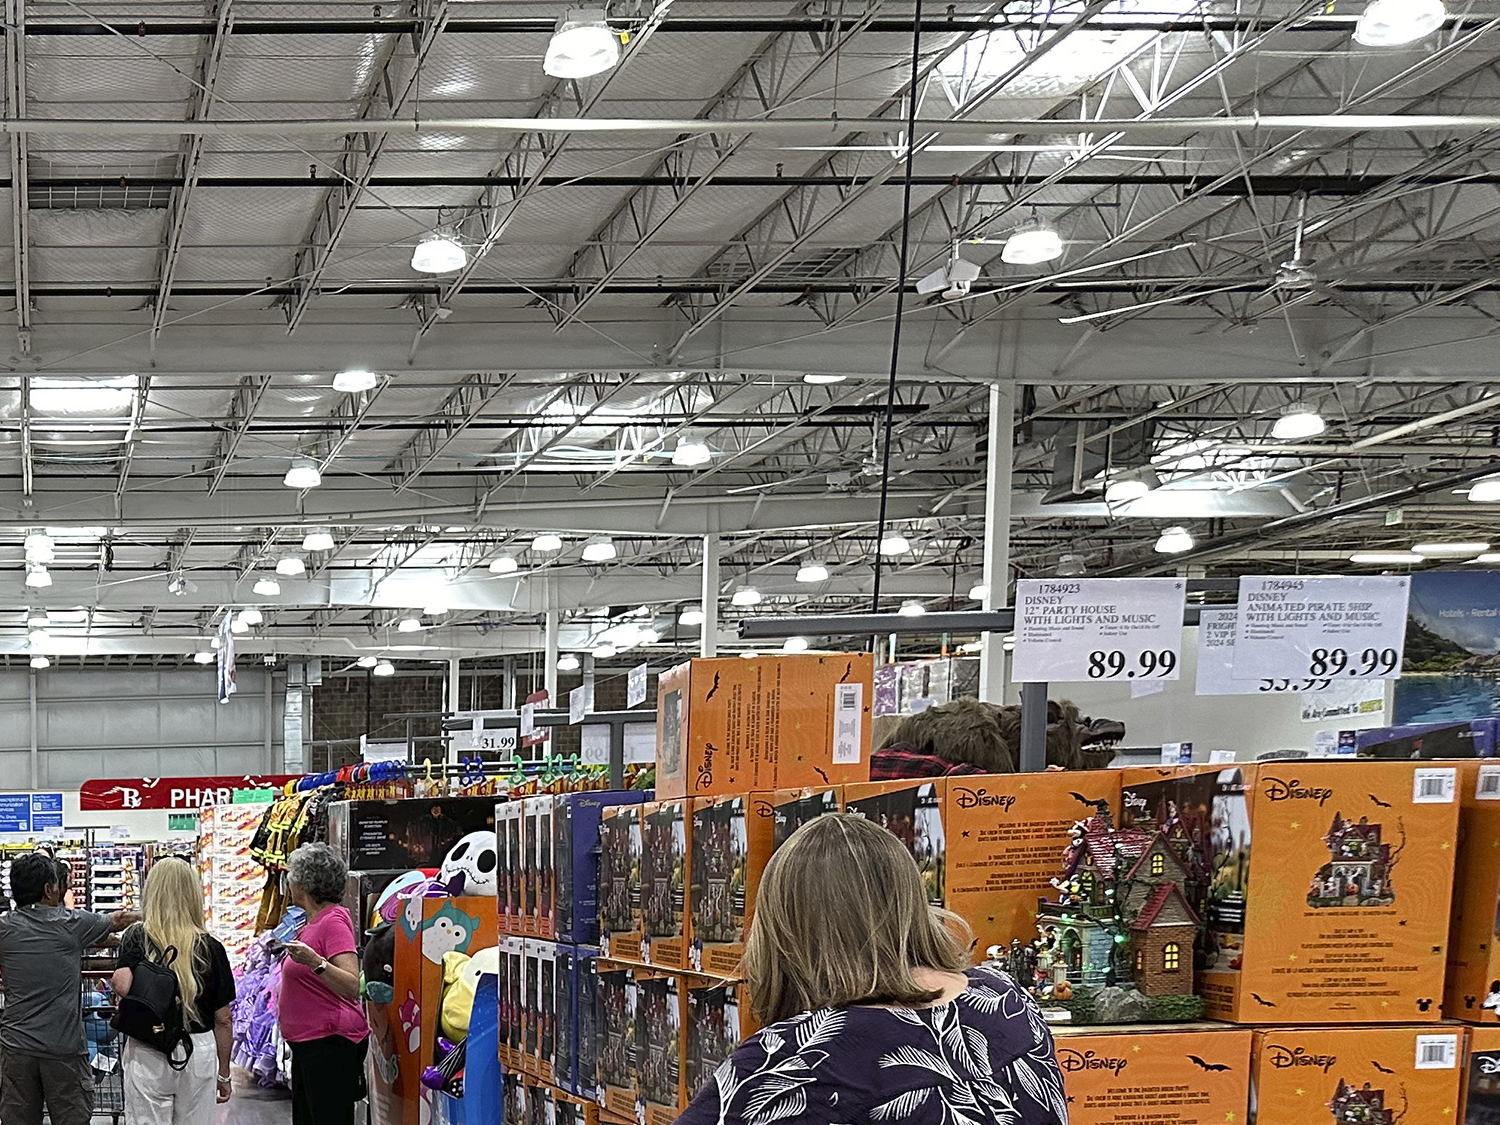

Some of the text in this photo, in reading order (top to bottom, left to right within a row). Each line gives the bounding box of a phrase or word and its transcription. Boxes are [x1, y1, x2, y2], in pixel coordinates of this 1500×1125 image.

[1038, 584, 1080, 594] 1784923
[1025, 596, 1064, 604] DISNEY
[1248, 593, 1288, 602] DISNEY
[1042, 606, 1078, 614] PARTY
[1080, 605, 1116, 614] HOUSE
[1247, 602, 1373, 612] ANIMATED PIRATE SHIP
[1024, 614, 1156, 624] WITH LIGHTS AND MUSIC
[1246, 612, 1380, 622] WITH LIGHTS AND MUSIC
[1087, 650, 1176, 678] 89.99
[1310, 648, 1398, 676] 89.99
[482, 737, 515, 750] 31.99
[695, 742, 718, 791] Disney
[953, 787, 1016, 812] Disney
[1262, 777, 1332, 806] Disney
[1123, 790, 1147, 810] Disney
[1058, 1048, 1128, 1076] Disney
[1267, 1044, 1336, 1074] Disney
